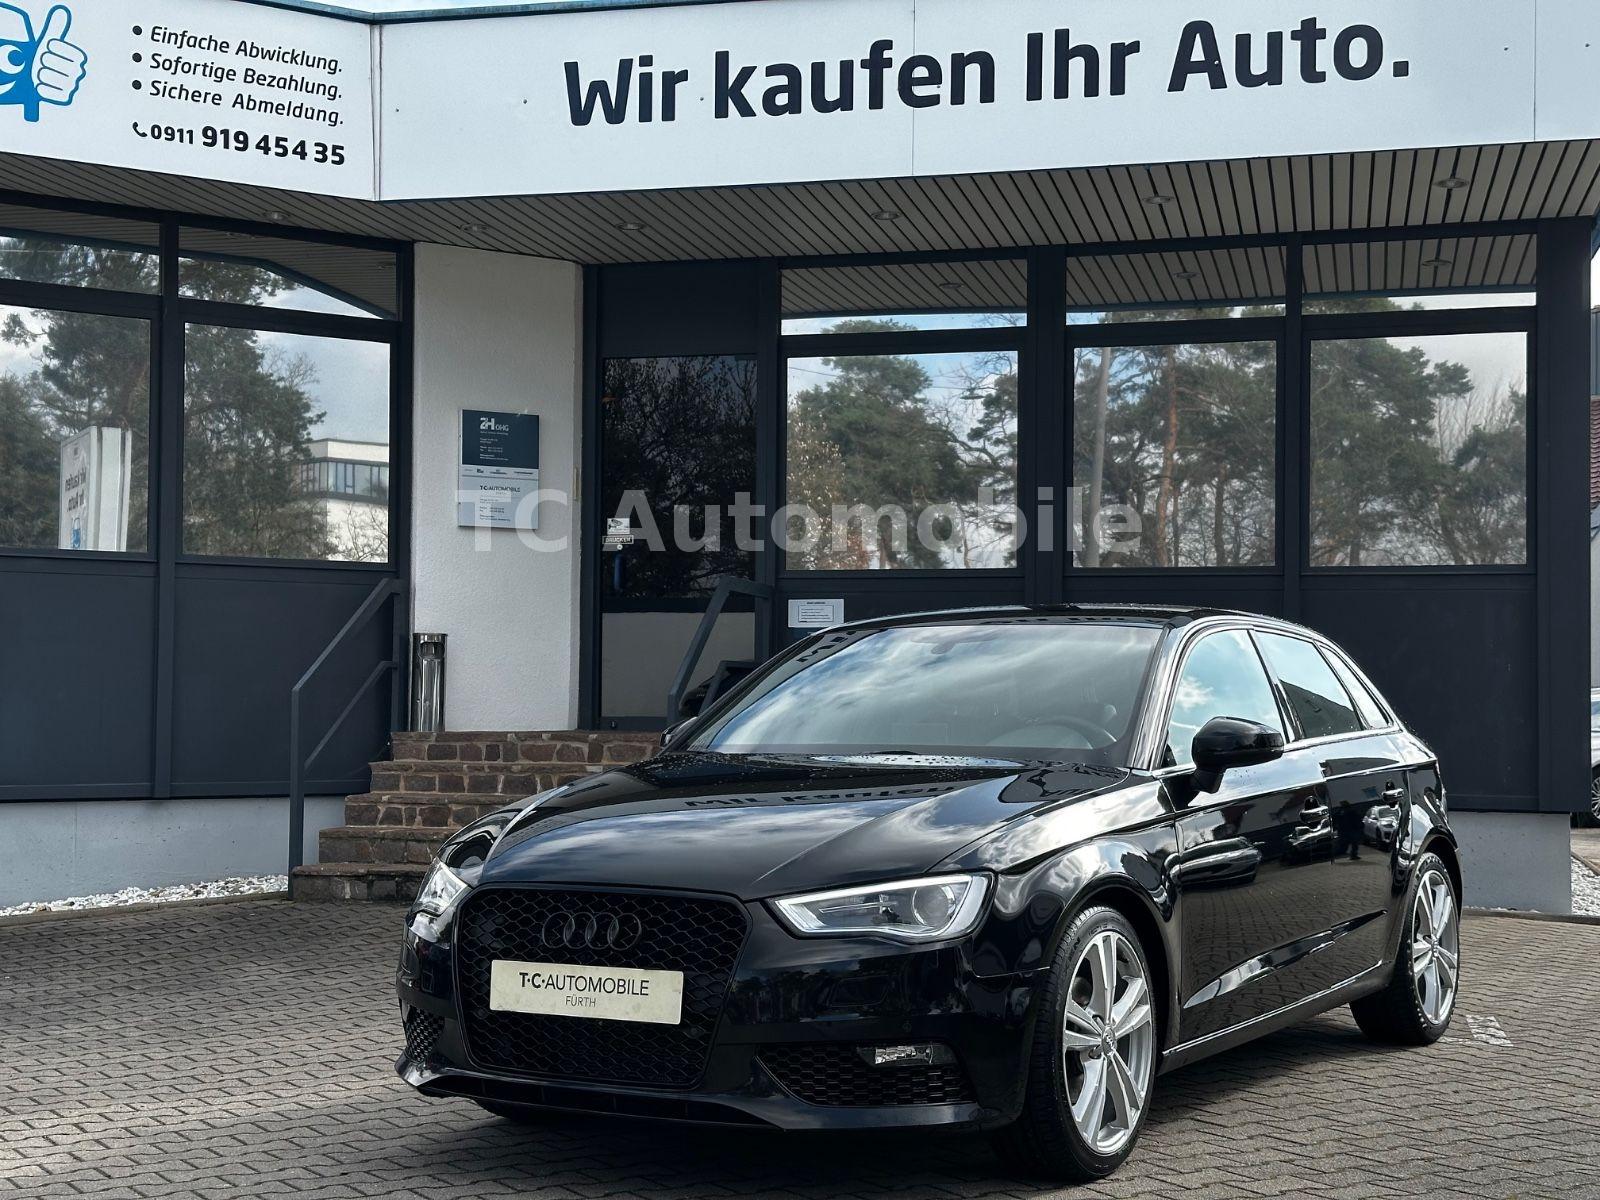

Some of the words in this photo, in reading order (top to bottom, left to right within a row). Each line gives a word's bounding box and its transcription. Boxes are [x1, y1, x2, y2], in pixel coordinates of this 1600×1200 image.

[150, 26, 230, 54] Einfache
[234, 40, 343, 74] Abwicklung.
[564, 54, 689, 127] Wir
[714, 39, 996, 119] kaufen
[1026, 28, 1141, 102] Ihr
[1167, 16, 1410, 93] Auto.
[149, 52, 237, 84] Sofortige
[243, 67, 343, 100] Bezahlung.
[149, 79, 223, 107] Sichere
[231, 92, 344, 127] Abmeldung.
[150, 124, 195, 145] 0911
[201, 125, 249, 152] 919
[565, 994, 597, 1008] FÜRTH
